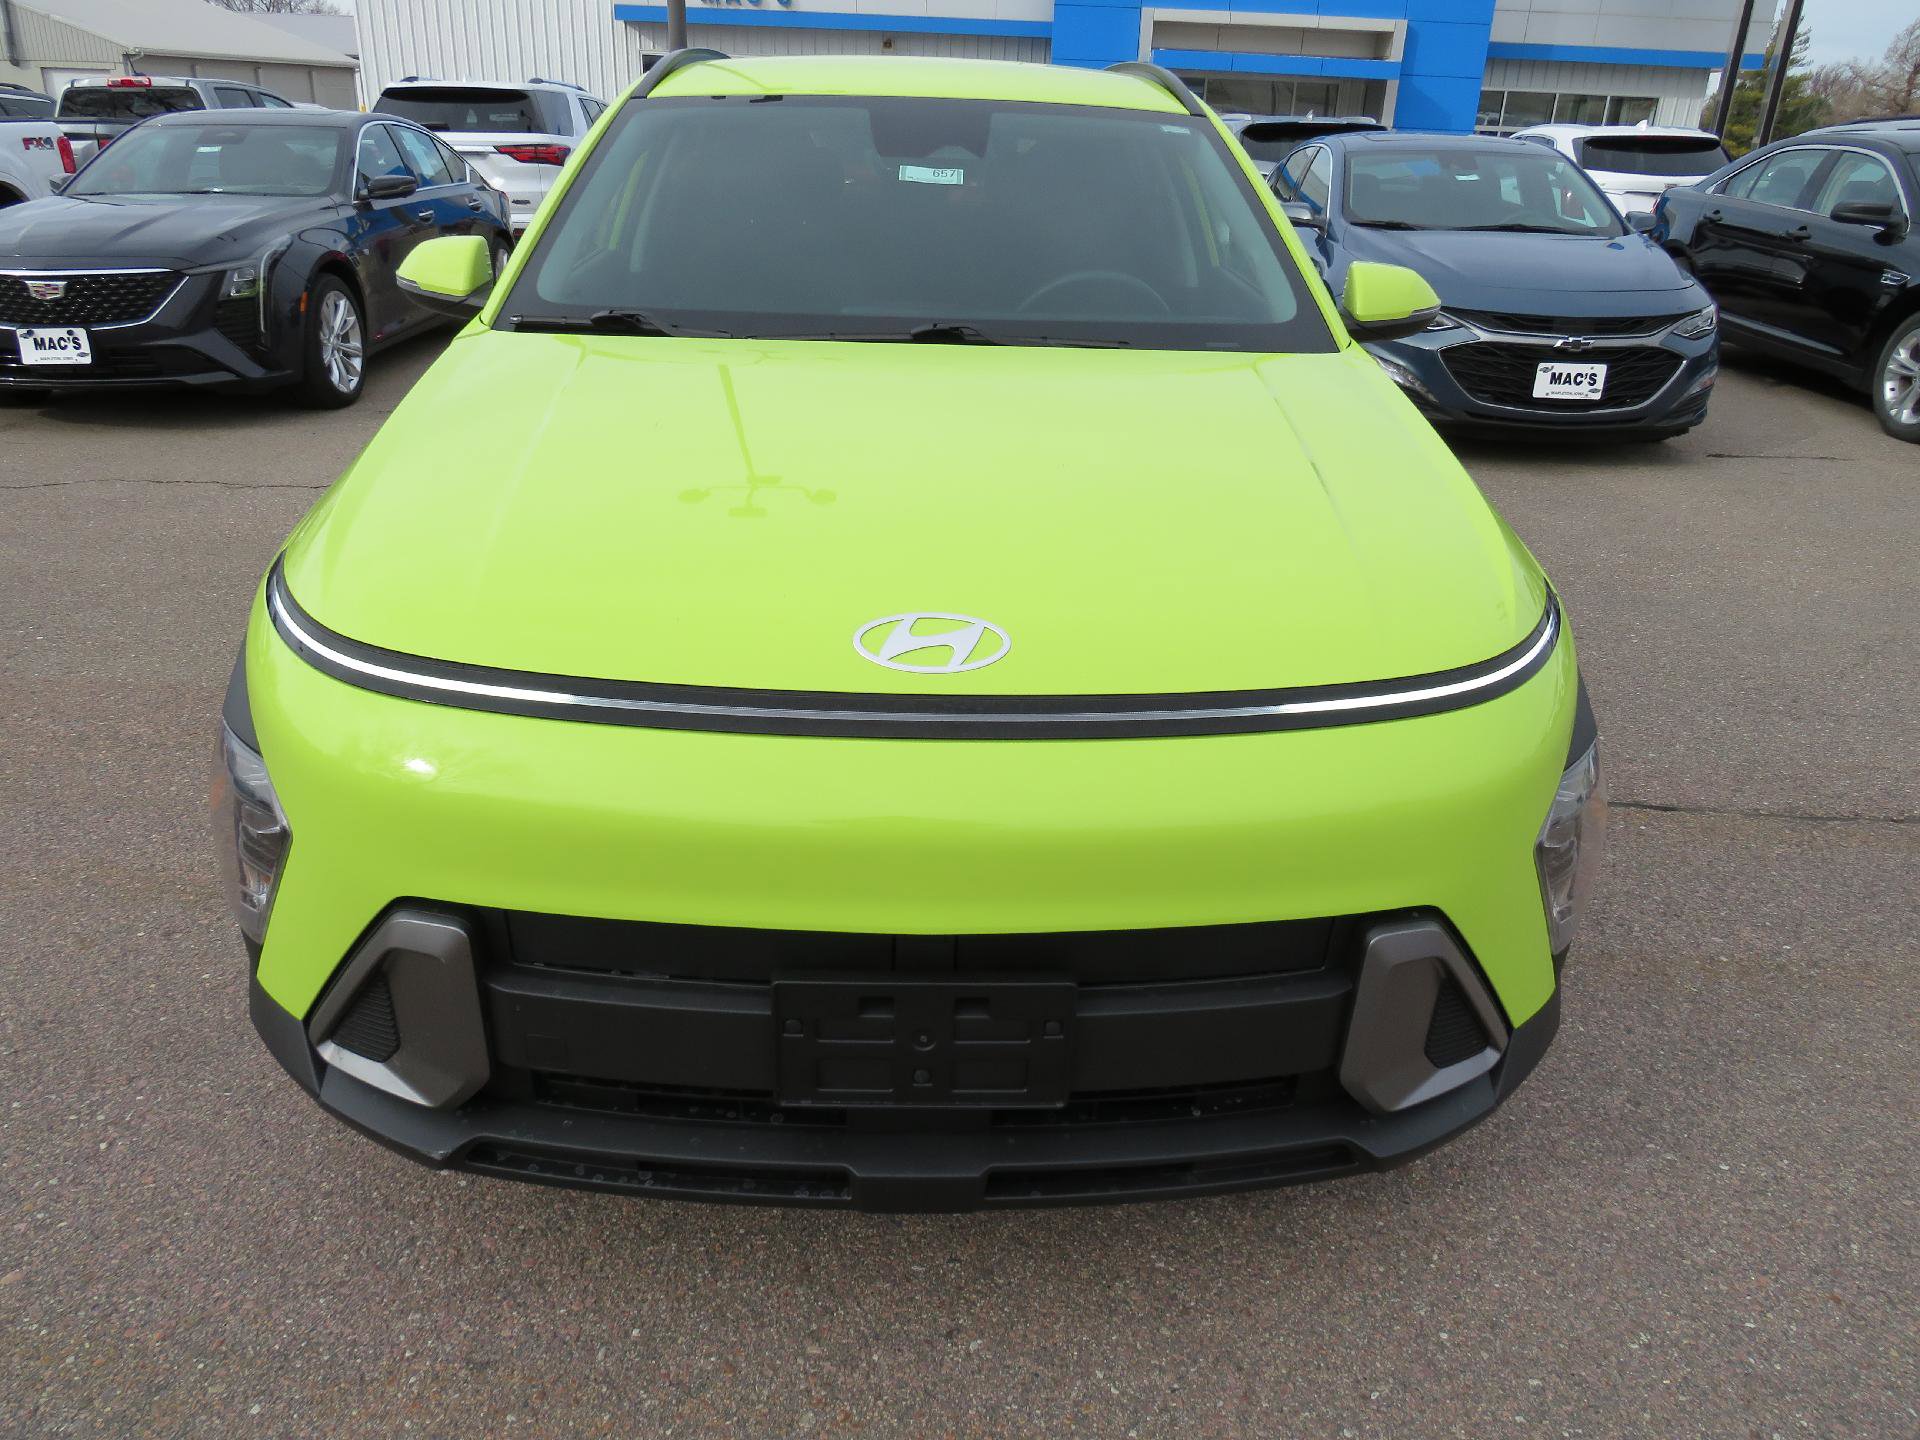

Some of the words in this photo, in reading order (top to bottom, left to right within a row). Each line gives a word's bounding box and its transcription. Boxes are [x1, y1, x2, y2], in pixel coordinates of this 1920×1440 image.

[22, 136, 55, 151] FX4
[932, 169, 956, 178] 657
[33, 336, 82, 351] MAC'S
[1549, 371, 1598, 387] MAC'S
